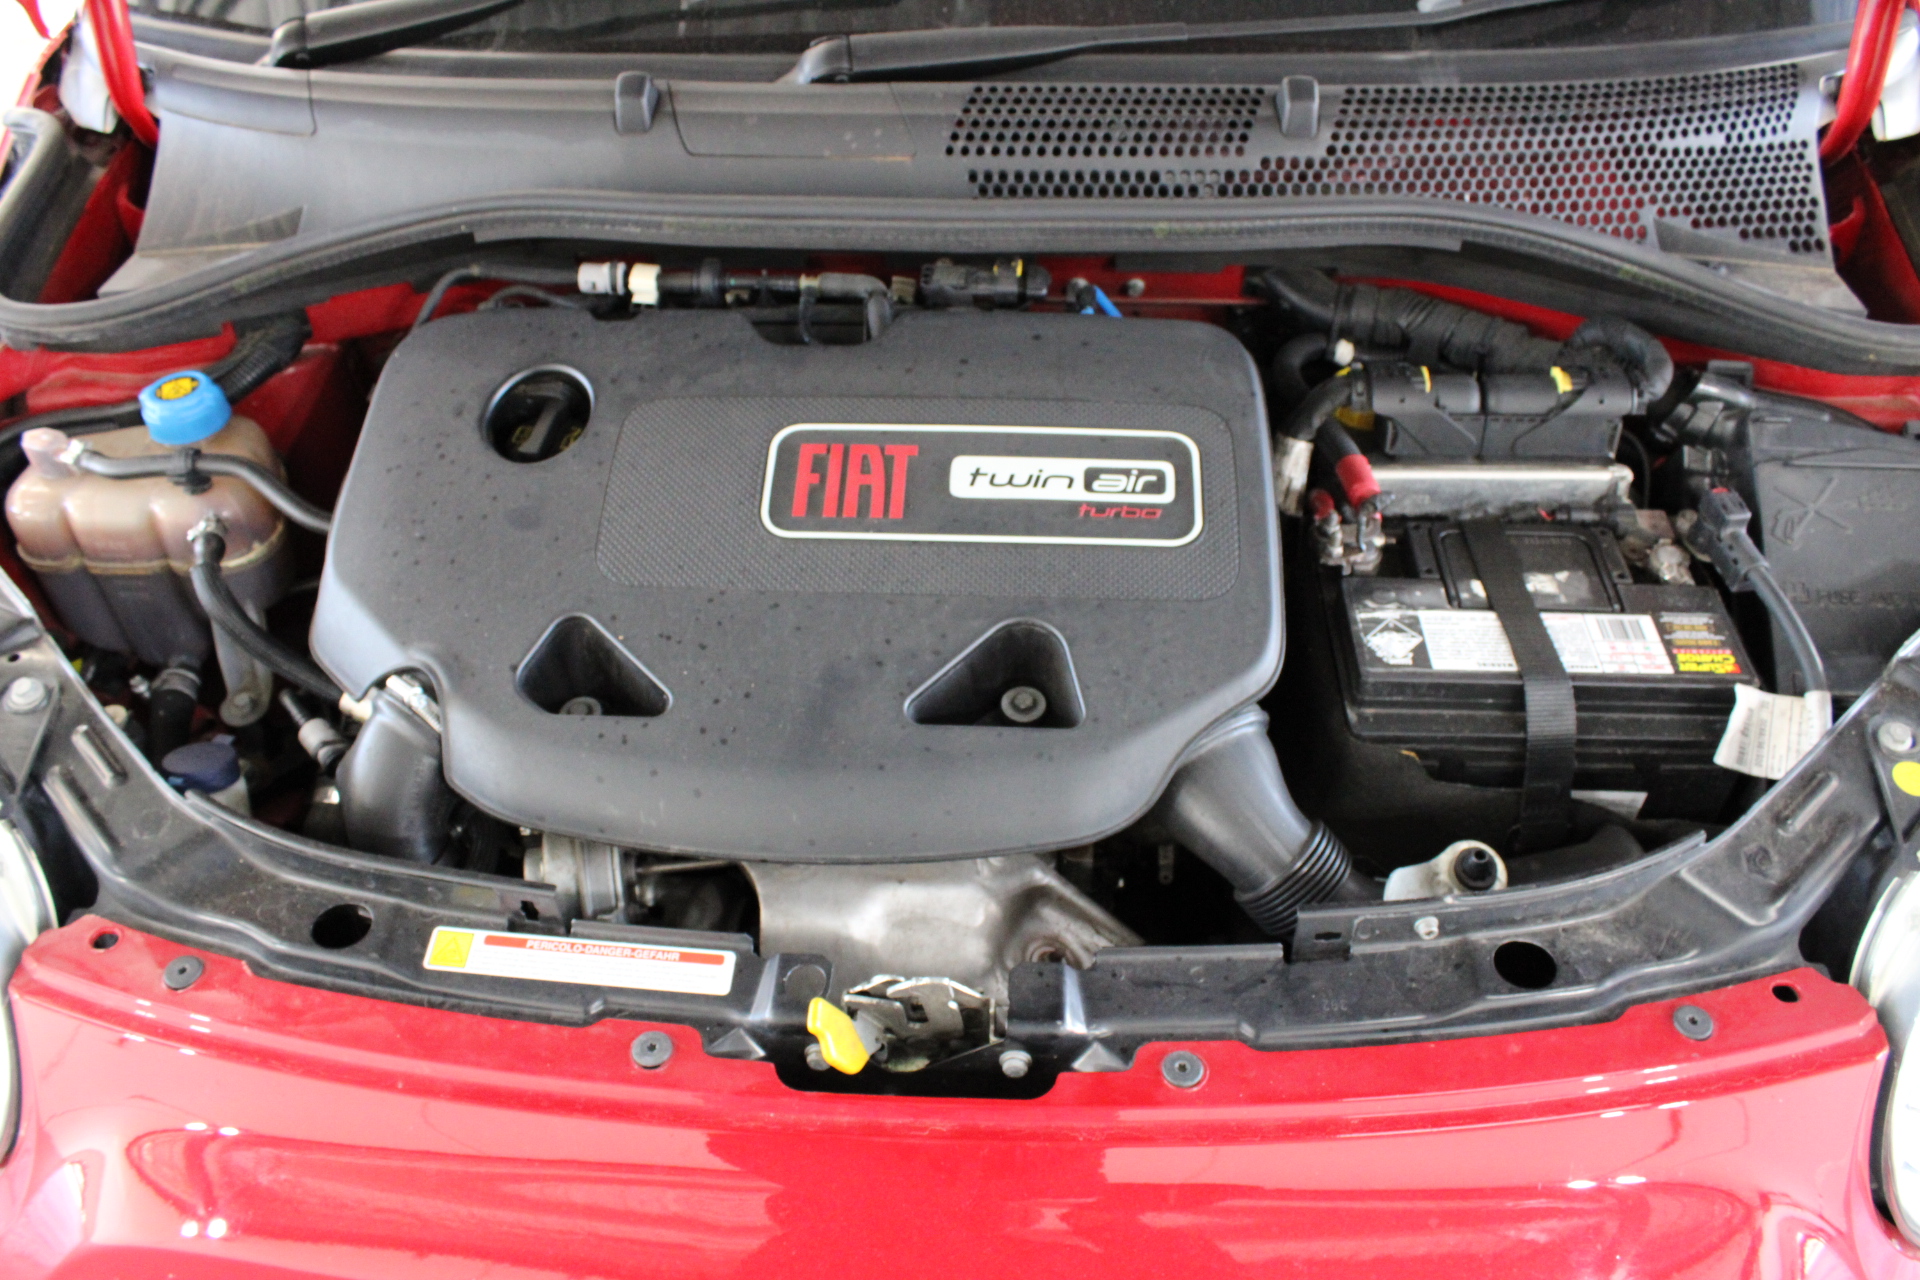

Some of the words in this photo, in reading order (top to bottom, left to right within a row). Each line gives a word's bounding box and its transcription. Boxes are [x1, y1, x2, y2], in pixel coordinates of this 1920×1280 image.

[792, 443, 919, 519] FIAT
[968, 466, 1074, 489] twin
[1092, 469, 1158, 493] air
[1078, 503, 1163, 519] turbo
